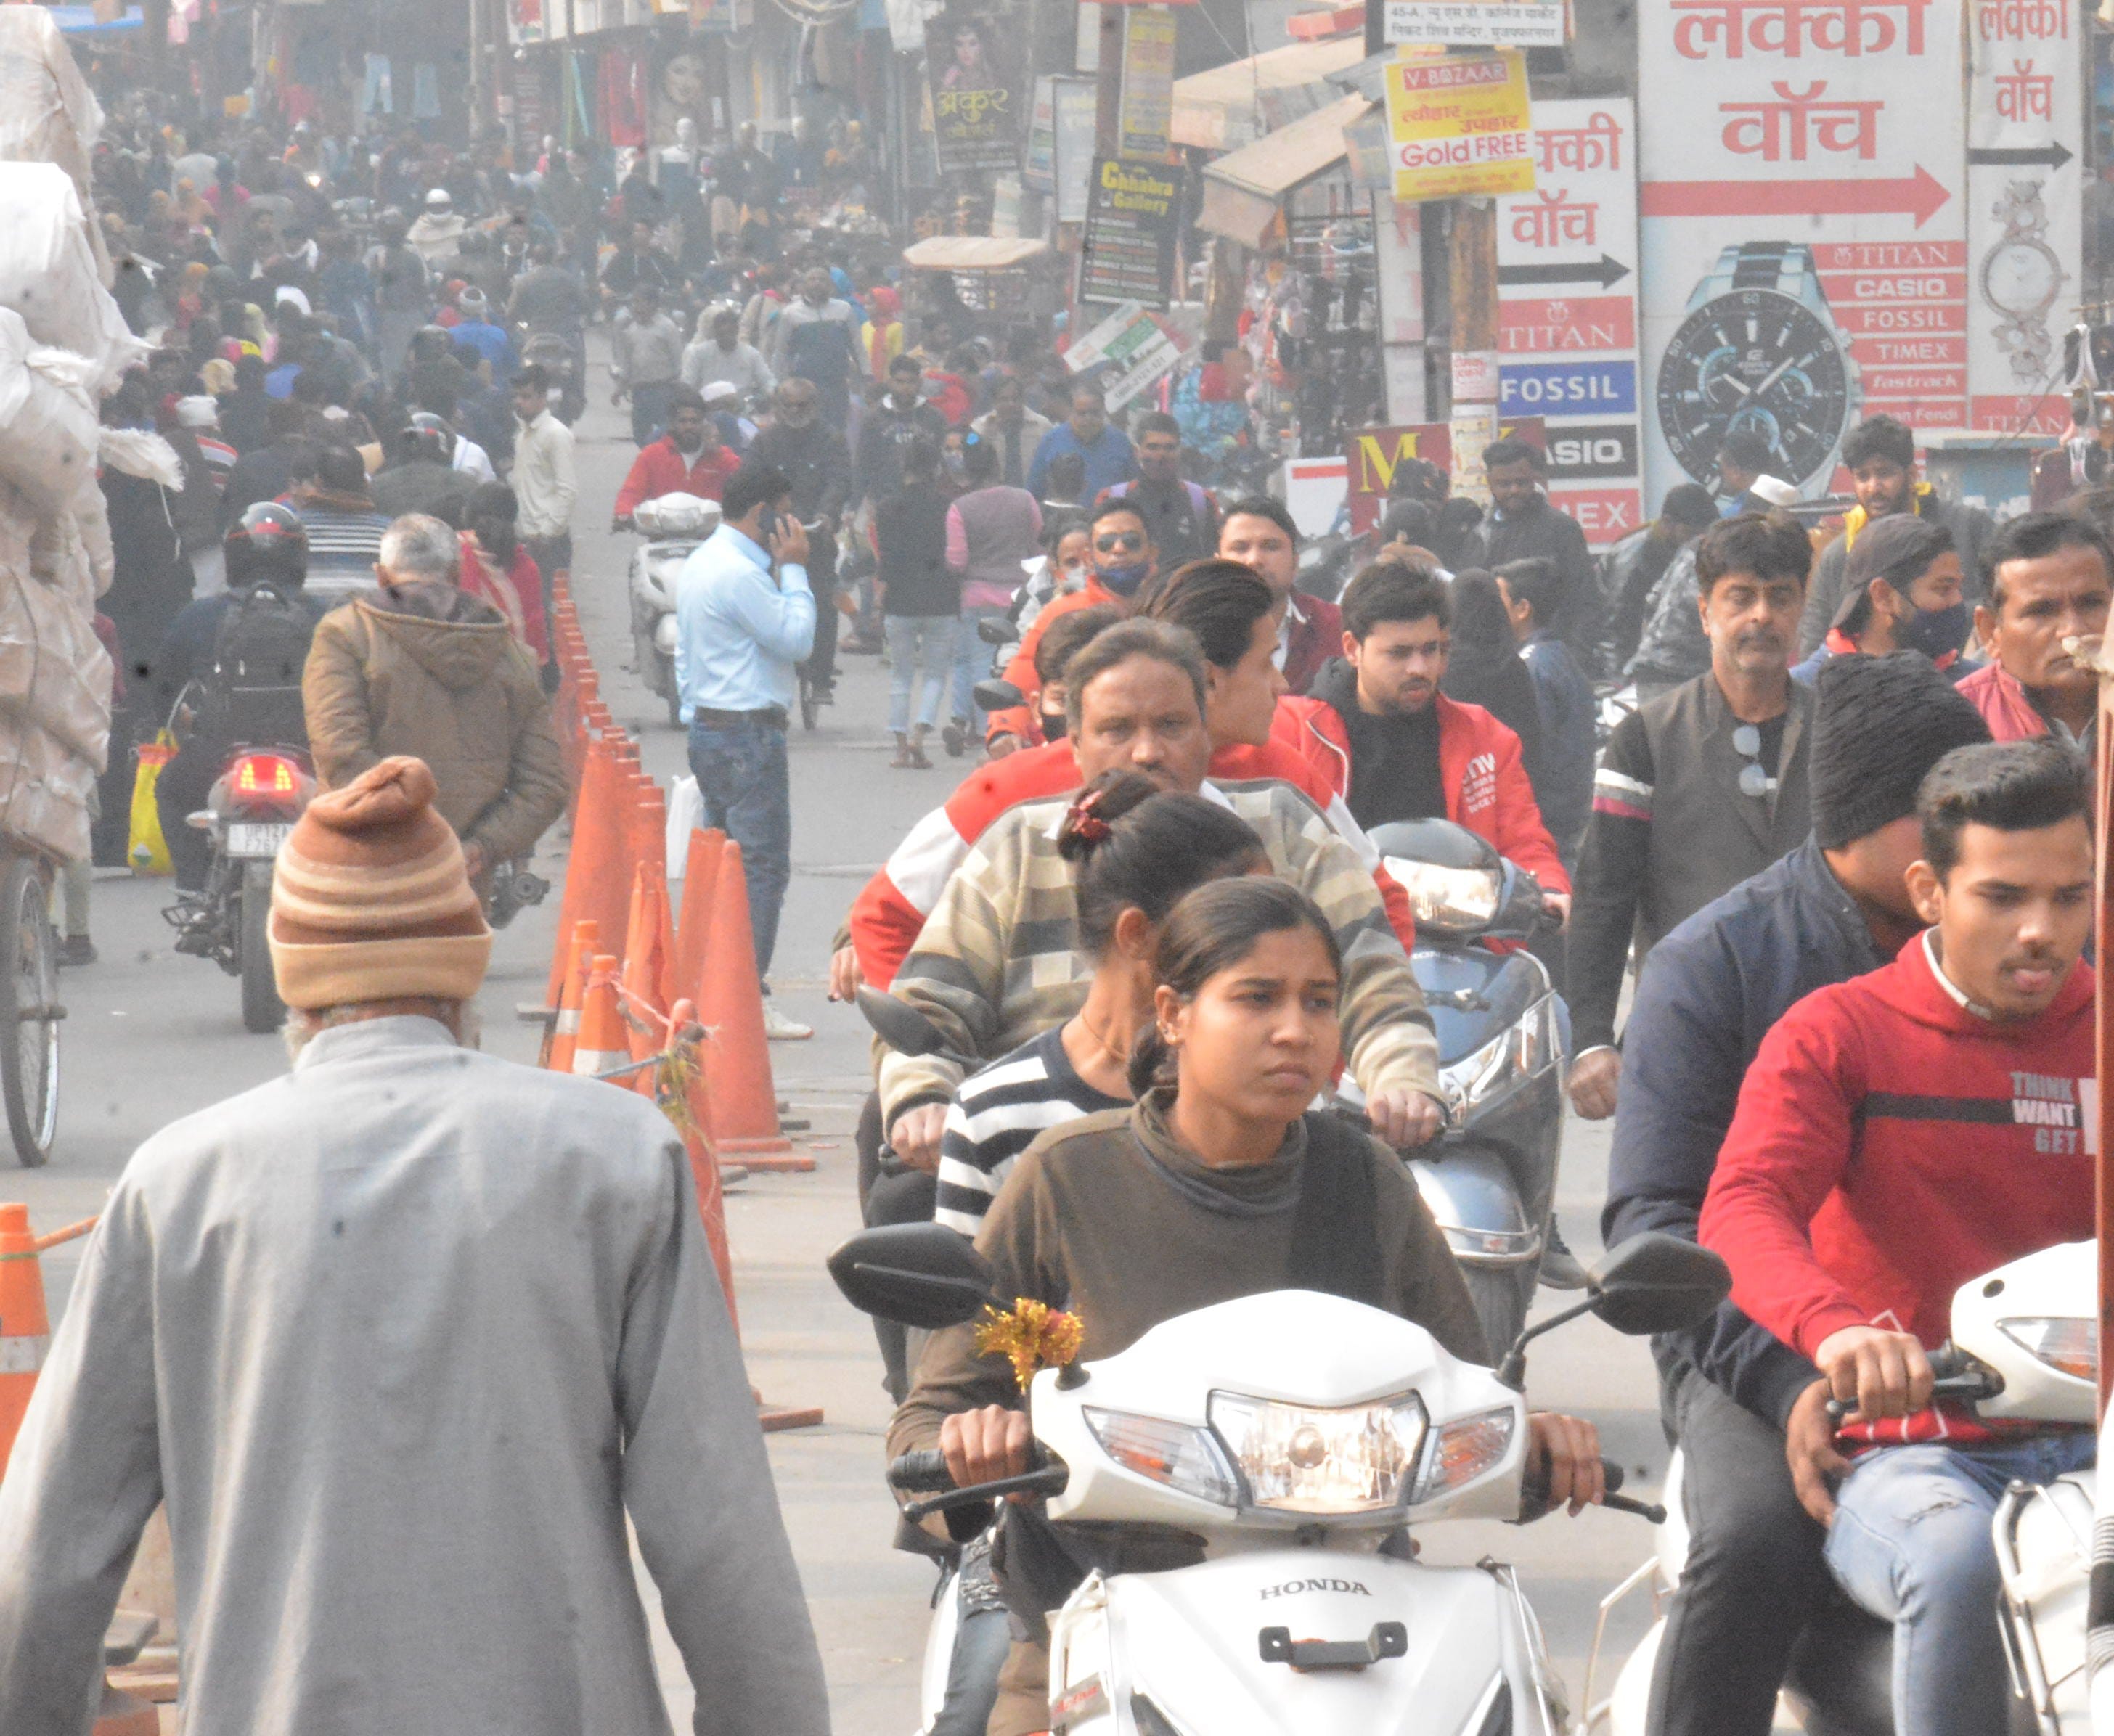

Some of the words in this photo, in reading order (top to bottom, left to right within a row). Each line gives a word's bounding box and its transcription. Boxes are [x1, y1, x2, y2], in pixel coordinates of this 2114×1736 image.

[1995, 59, 2054, 122] वॉच
[1719, 81, 1885, 161] वॉच
[1400, 139, 1471, 168] Gold
[1475, 132, 1527, 157] FREE
[1535, 111, 1623, 173] क्की
[1511, 188, 1599, 247] वॉच
[1856, 245, 1949, 266] TITAN
[1854, 278, 1948, 298] CASIO
[1863, 309, 1948, 329] FOSSIL
[1500, 324, 1615, 350] TITAN
[1876, 343, 1949, 360] TIMEX
[1501, 374, 1619, 403] FOSSIL
[1545, 439, 1623, 466] SIO
[2009, 1071, 2074, 1101] THINK
[2012, 1098, 2076, 1127] WANT
[2035, 1128, 2078, 1155] GET
[1260, 1578, 1374, 1601] HONDA
